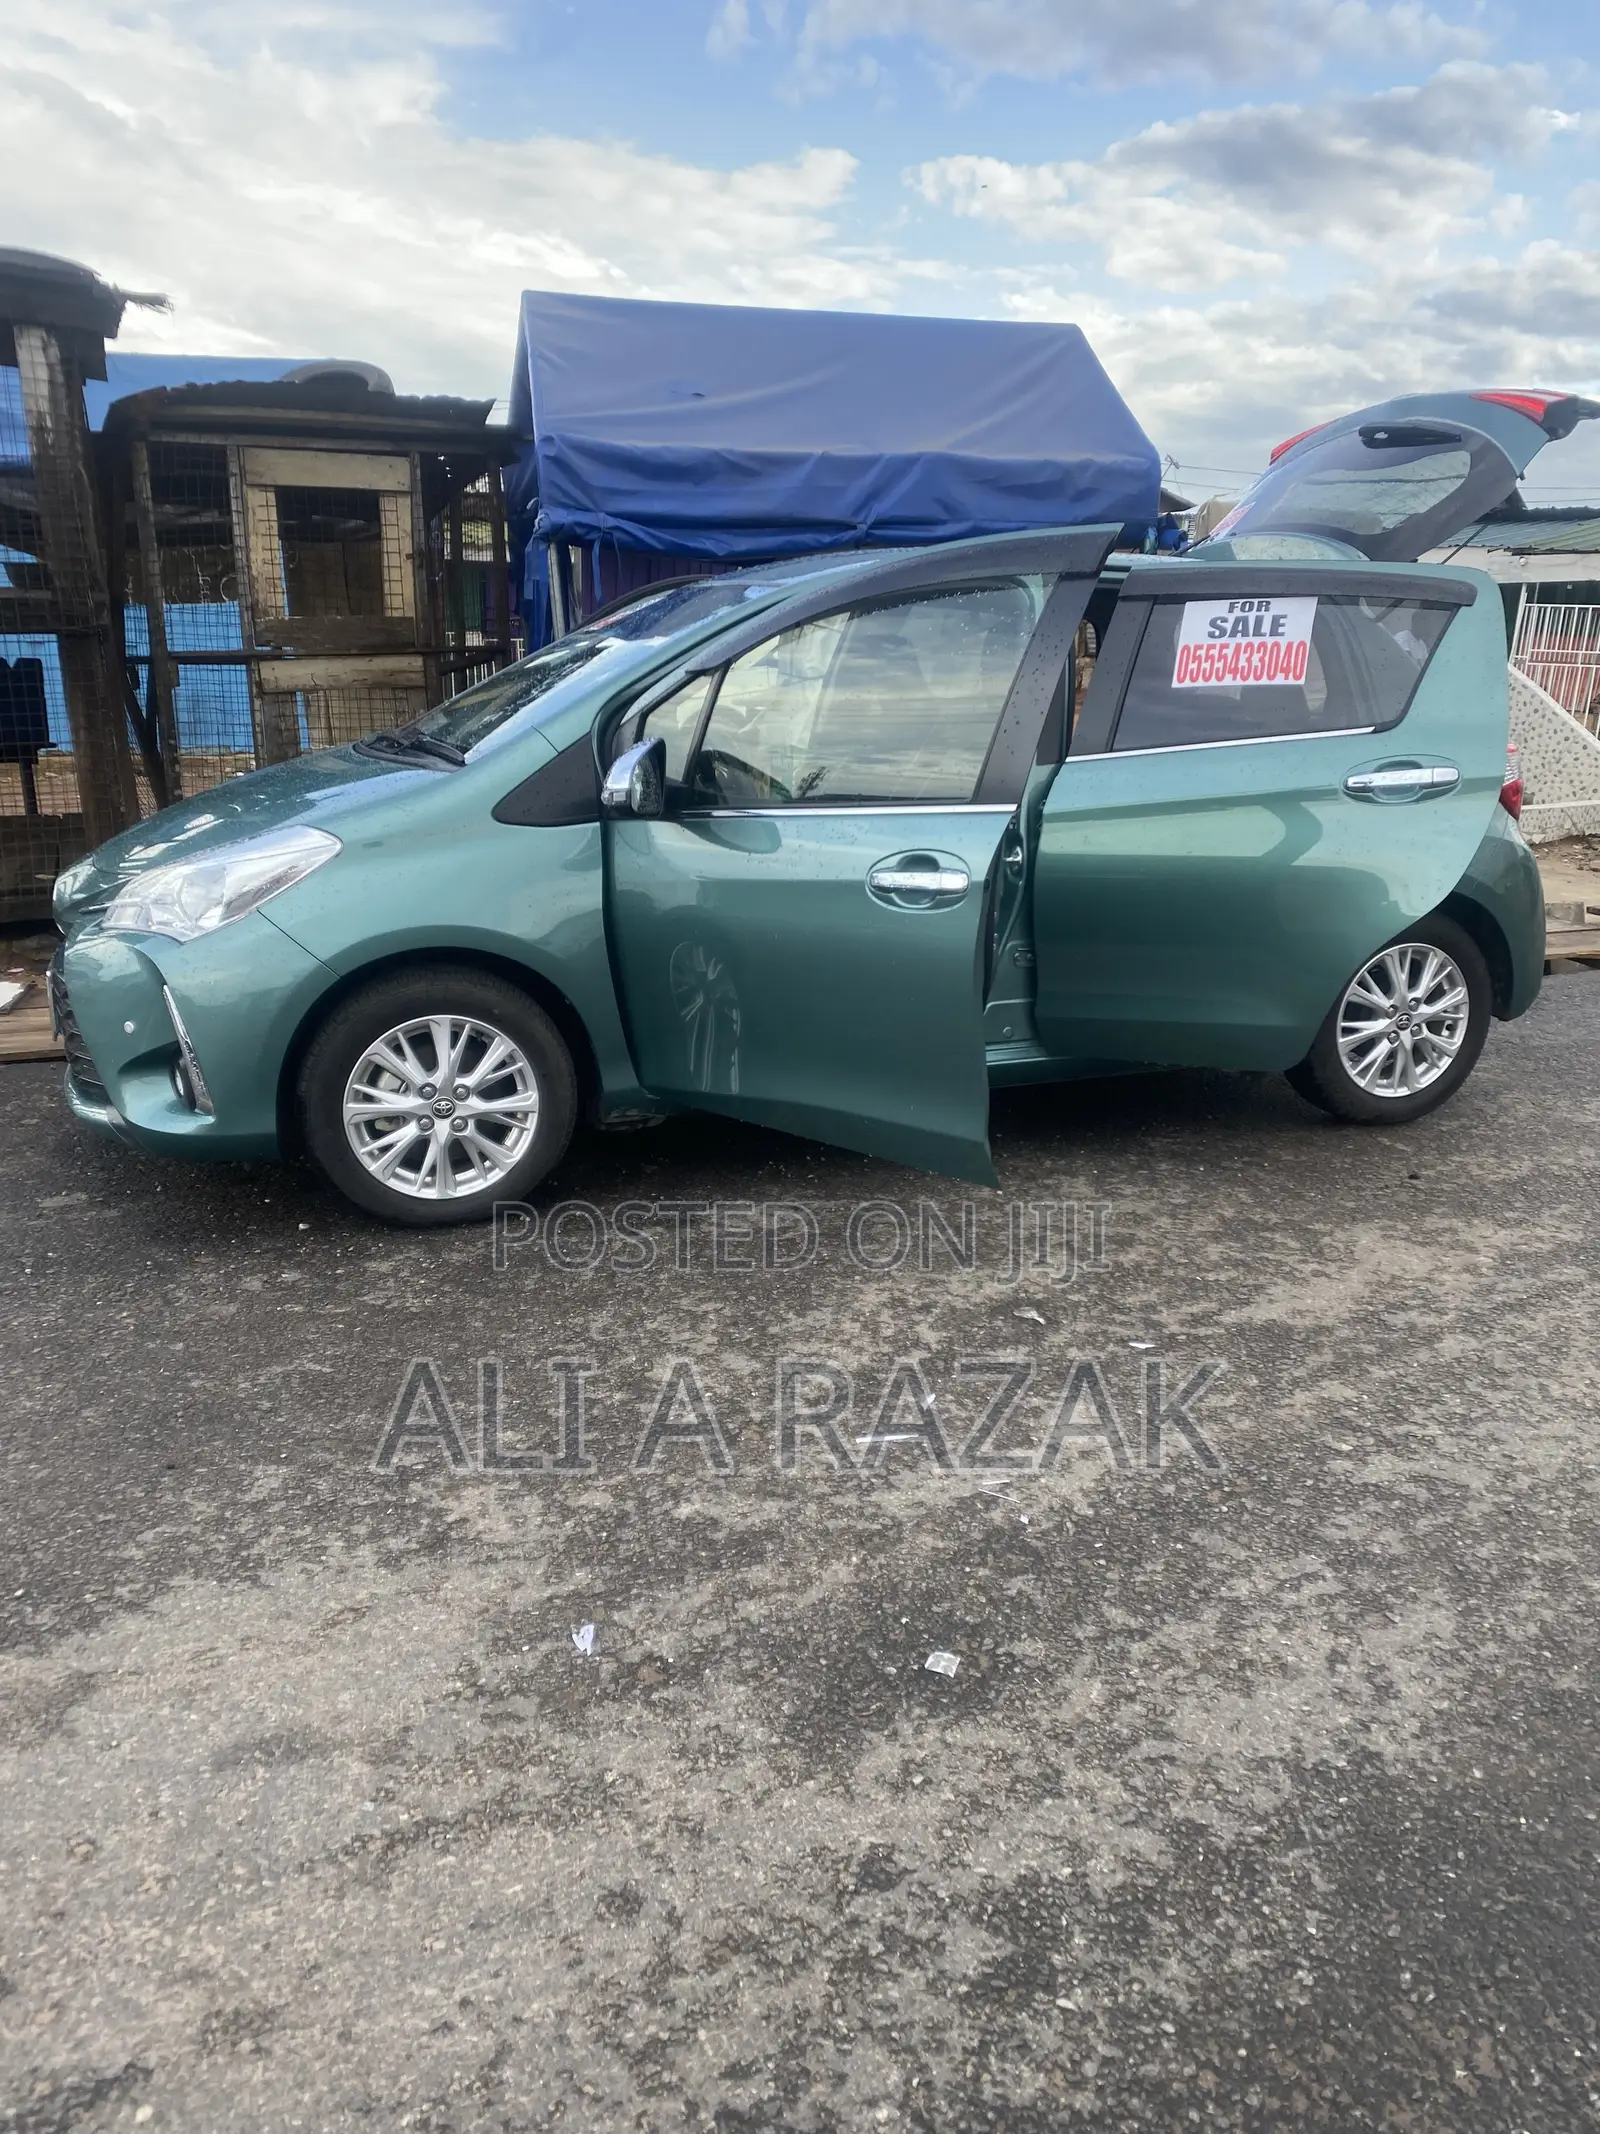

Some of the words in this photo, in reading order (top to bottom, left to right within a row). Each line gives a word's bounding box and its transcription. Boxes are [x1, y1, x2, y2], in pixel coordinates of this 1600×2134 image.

[1228, 600, 1271, 613] FOR
[1207, 615, 1287, 638] SALE
[1177, 641, 1307, 683] 0555433040
